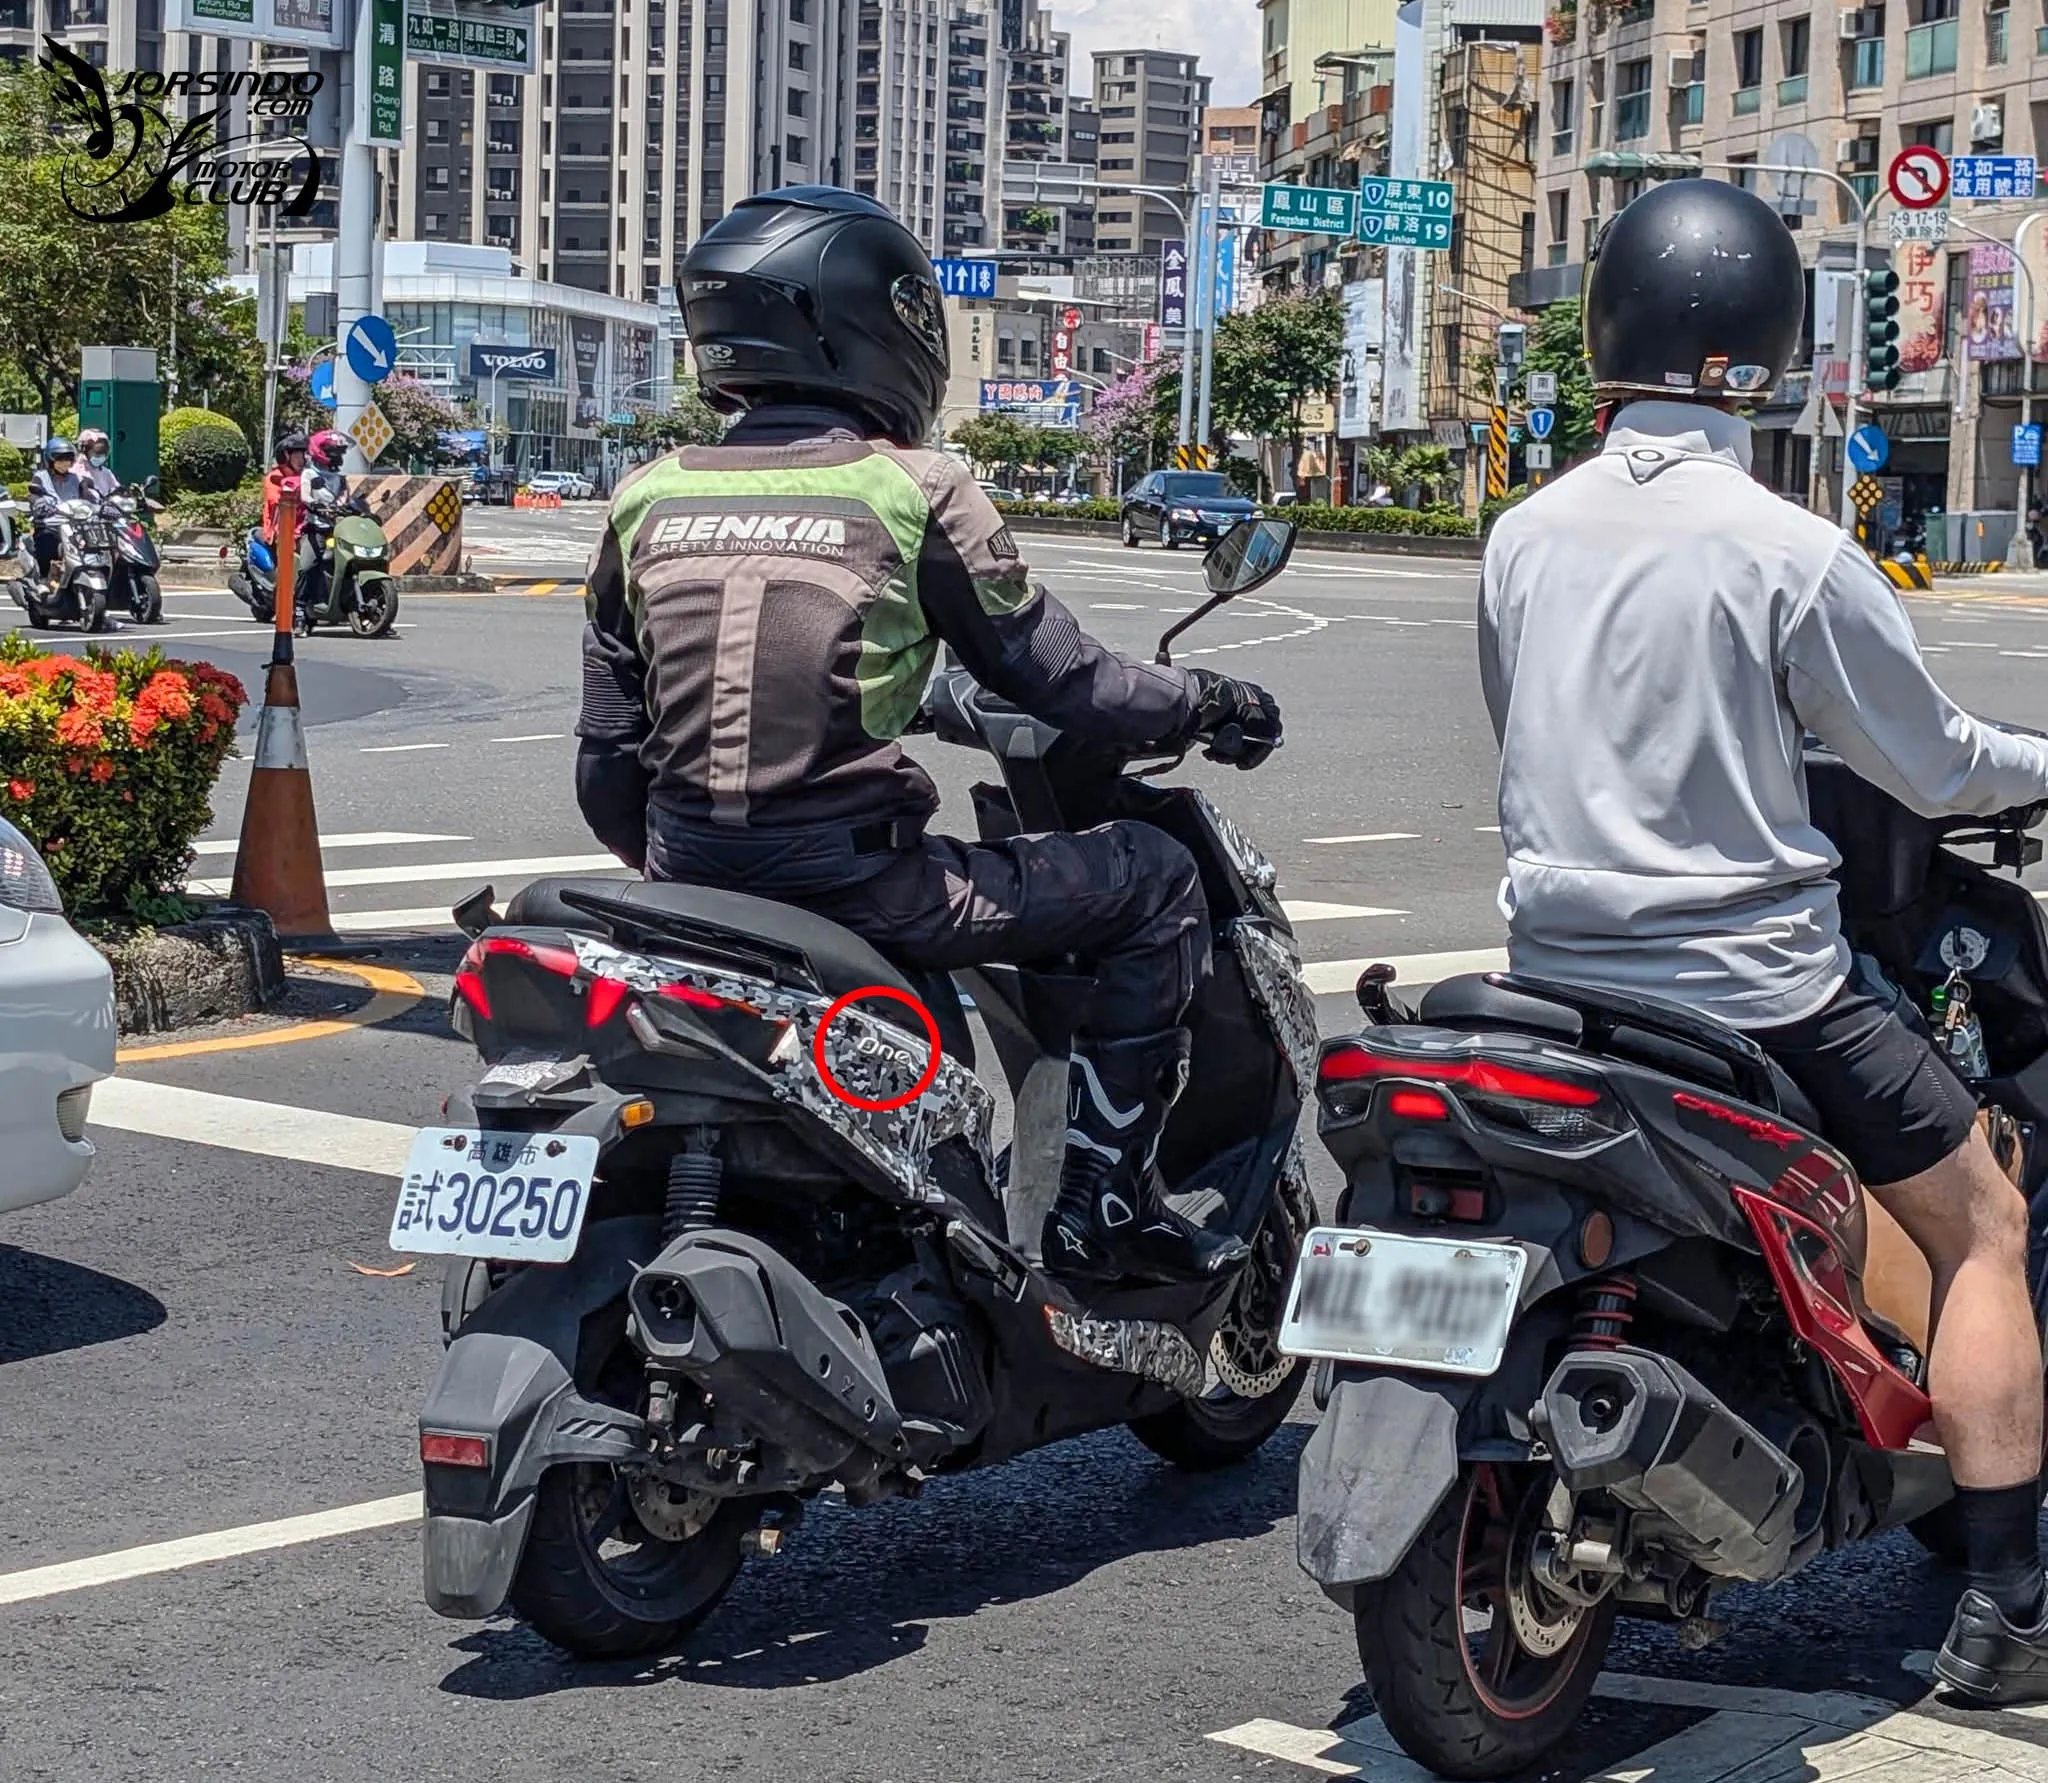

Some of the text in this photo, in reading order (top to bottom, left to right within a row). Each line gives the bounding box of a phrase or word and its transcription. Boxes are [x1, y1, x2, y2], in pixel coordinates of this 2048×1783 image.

[409, 17, 460, 39] 九如一路
[379, 0, 396, 88] 清路
[373, 93, 400, 108] Cheng
[1955, 160, 2032, 177] 九如一路
[1386, 182, 1422, 200] 屏東
[1954, 178, 2031, 196] 專用號誌
[1272, 190, 1345, 216] 鳳山區
[1384, 199, 1423, 213] Pingtung
[1427, 191, 1450, 208] 10
[1270, 212, 1345, 229] Fengshan District
[1890, 211, 1948, 226] 7-9 17-19
[1425, 223, 1448, 240] 19
[1890, 226, 1947, 239] 公車除外
[480, 353, 546, 369] VOLVO
[649, 515, 847, 545] BENKIA
[650, 540, 845, 556] SAFETY & INNOVATION
[467, 1140, 541, 1165] 高雄市
